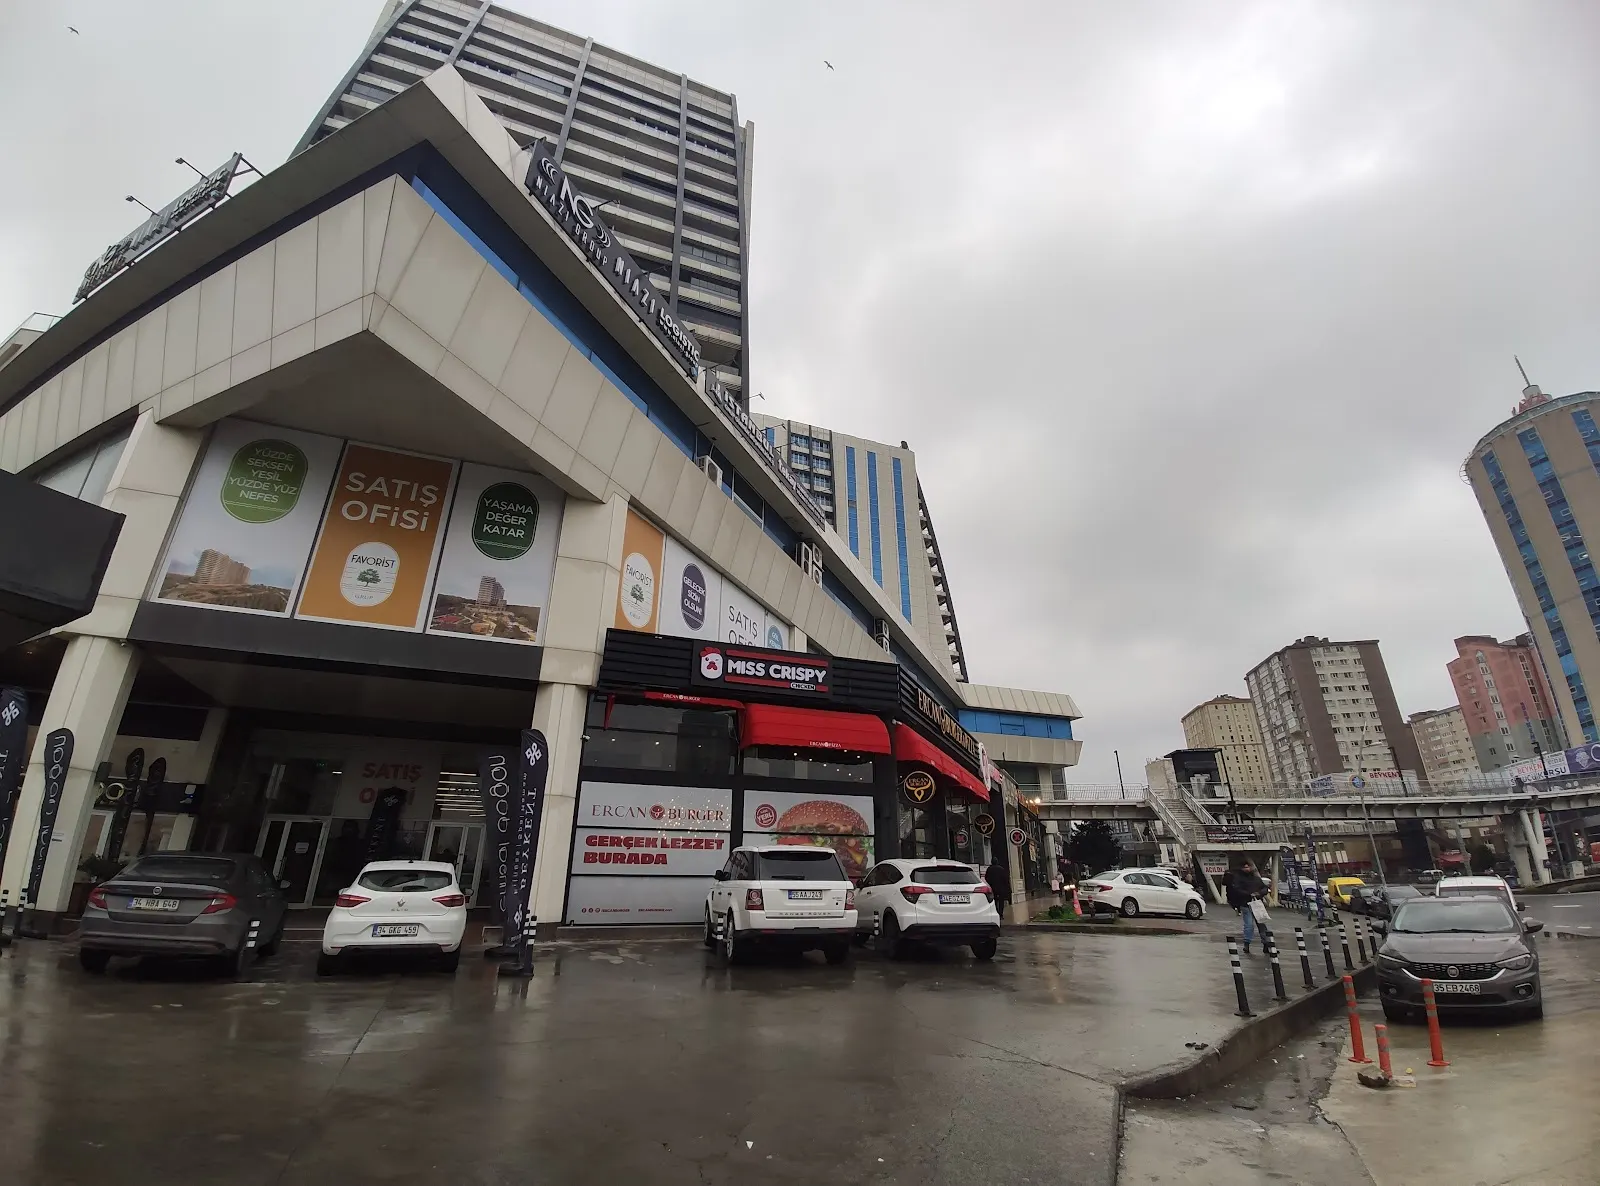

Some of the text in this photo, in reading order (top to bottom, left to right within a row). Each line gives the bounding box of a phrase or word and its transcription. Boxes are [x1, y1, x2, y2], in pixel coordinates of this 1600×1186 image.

[536, 175, 608, 266] NIAZI GROUP
[615, 257, 656, 314] NIAZI
[660, 307, 700, 361] LOGISTIC
[255, 447, 294, 461] YÜZDE
[247, 457, 294, 472] SEKSEN
[251, 469, 282, 482] YEŞİL
[229, 476, 298, 495] YÜZDE YÜZ
[345, 472, 439, 508] SATIŞ
[239, 490, 279, 503] NEFES
[483, 497, 534, 515] YAŞAMA
[485, 511, 527, 526] DEĞER
[482, 523, 525, 539] KATAR
[683, 576, 706, 597] GELECEK
[728, 605, 758, 639] SATIŞ
[727, 659, 827, 683] MISS CRISPY
[791, 682, 816, 690] CHICKEN
[683, 694, 701, 702] BURGER
[592, 804, 724, 821] ERCAN BURGER
[585, 835, 725, 850] GERÇEK LEZZET
[583, 851, 668, 865] BURADA
[377, 926, 417, 934] 34 GKG 459
